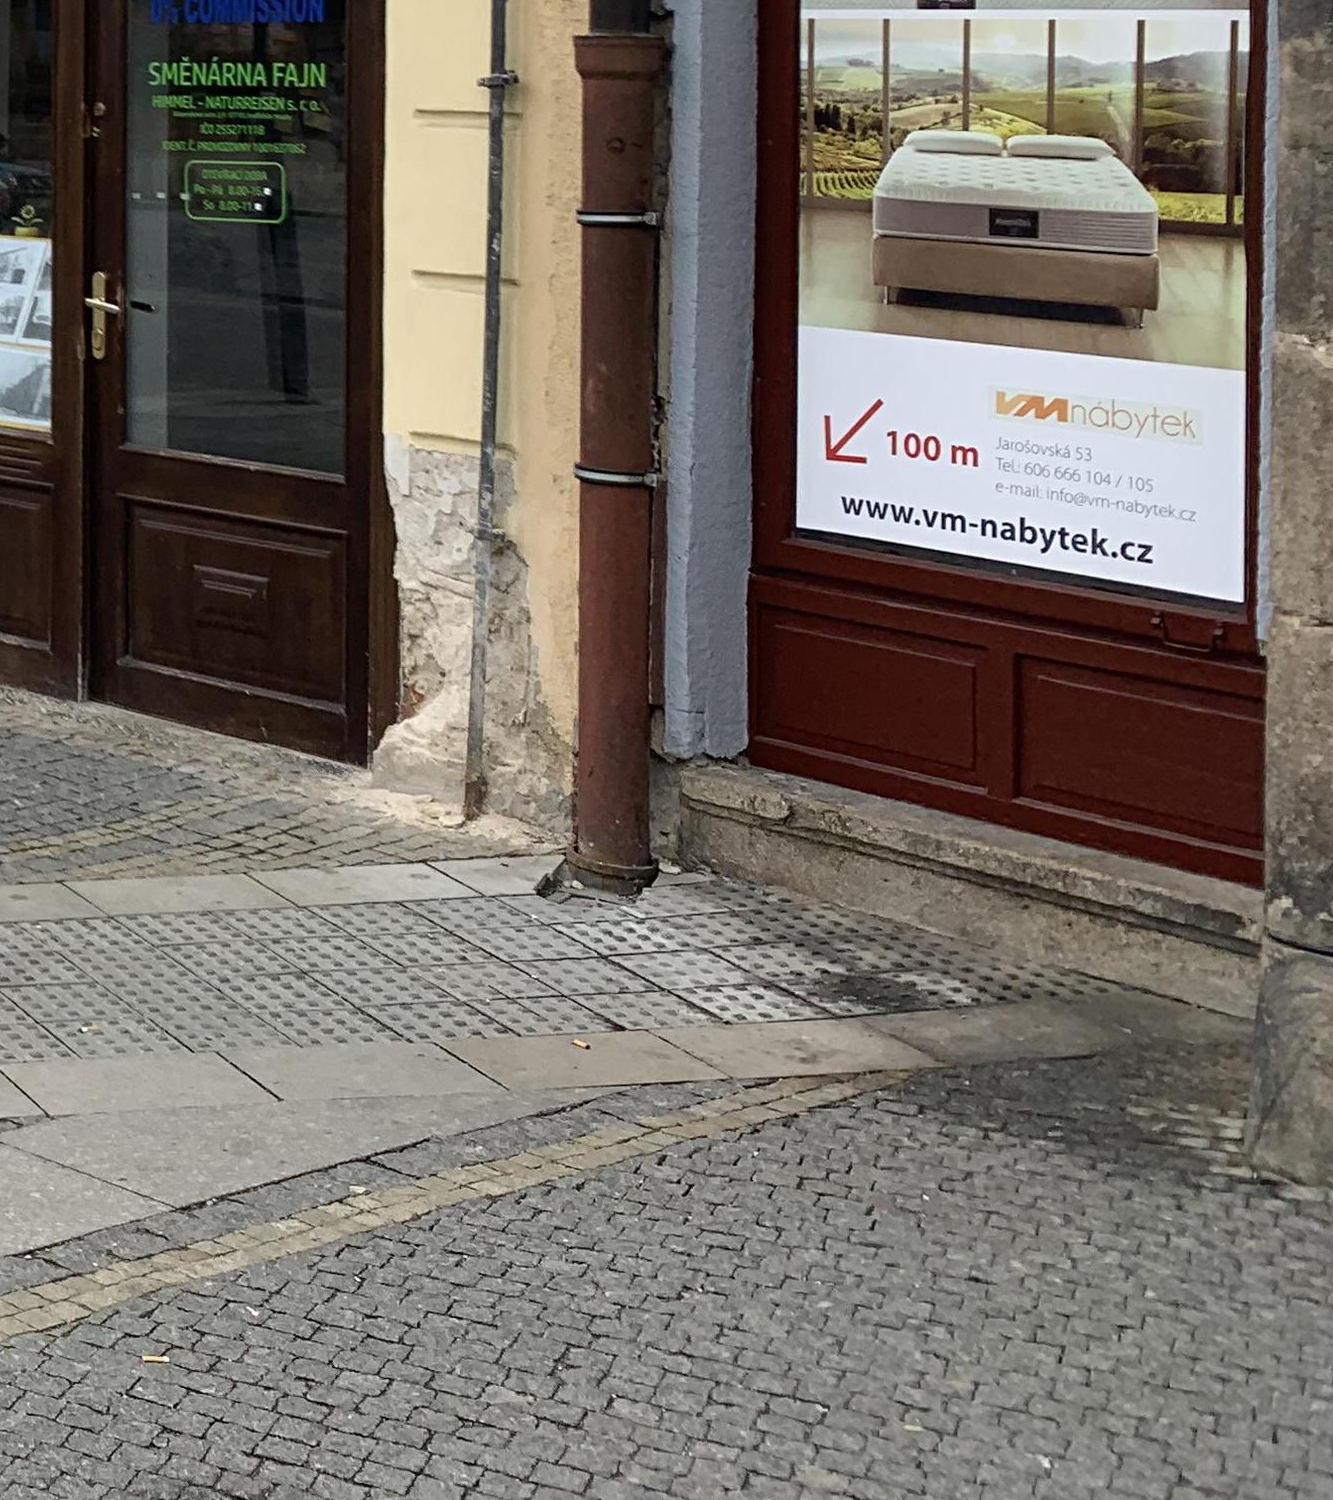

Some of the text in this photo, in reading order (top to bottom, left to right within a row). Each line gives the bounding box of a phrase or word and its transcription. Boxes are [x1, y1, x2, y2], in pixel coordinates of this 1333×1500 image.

[148, 56, 326, 88] SMĚNÁRNA FAJN
[886, 430, 979, 467] 100 m
[996, 436, 1093, 462] Jarošovská 53
[1024, 462, 1051, 479] 606
[1054, 466, 1081, 483] 666
[1086, 470, 1111, 486] 104
[1128, 476, 1154, 493] 105
[995, 482, 1197, 522] e-mail: info@vm-nabytek.cz
[841, 495, 1154, 564] www.vm-nabytek.cz
